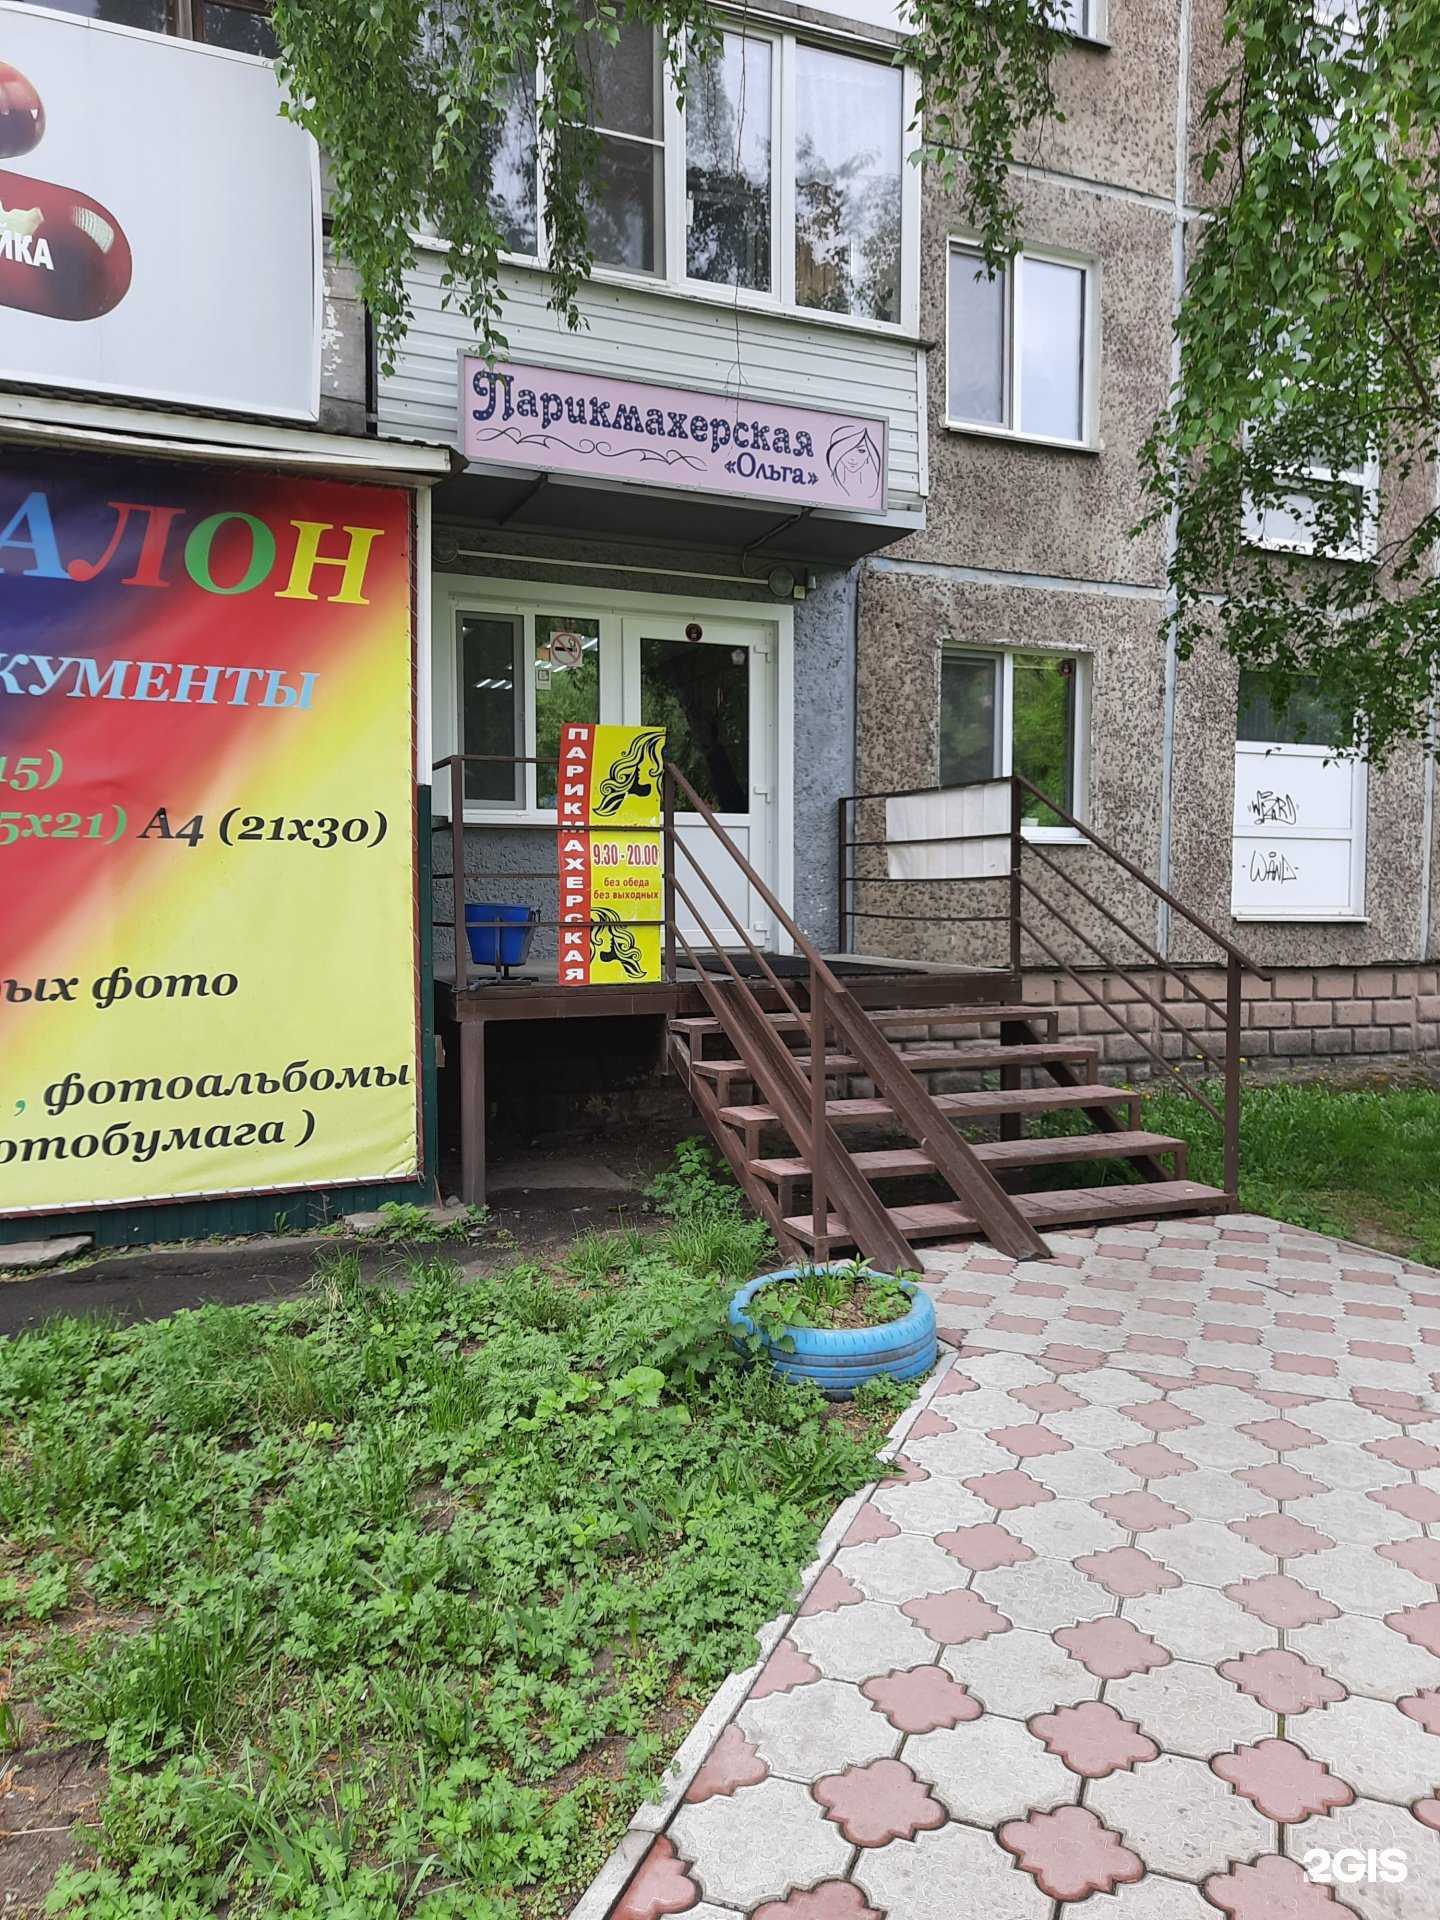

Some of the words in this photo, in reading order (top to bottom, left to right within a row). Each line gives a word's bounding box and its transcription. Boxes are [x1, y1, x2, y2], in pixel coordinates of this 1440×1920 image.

[471, 368, 814, 458] Парикмахерская
[724, 452, 819, 486] «Ольга»
[0, 491, 385, 605] АЛОН
[0, 653, 321, 711] КУМЕНТЫ
[593, 889, 610, 900] без
[612, 891, 659, 900] выходных
[603, 876, 620, 887] без
[622, 877, 650, 889] обеда
[92, 966, 239, 1009] фото
[43, 1059, 410, 1116] фотоальбомы
